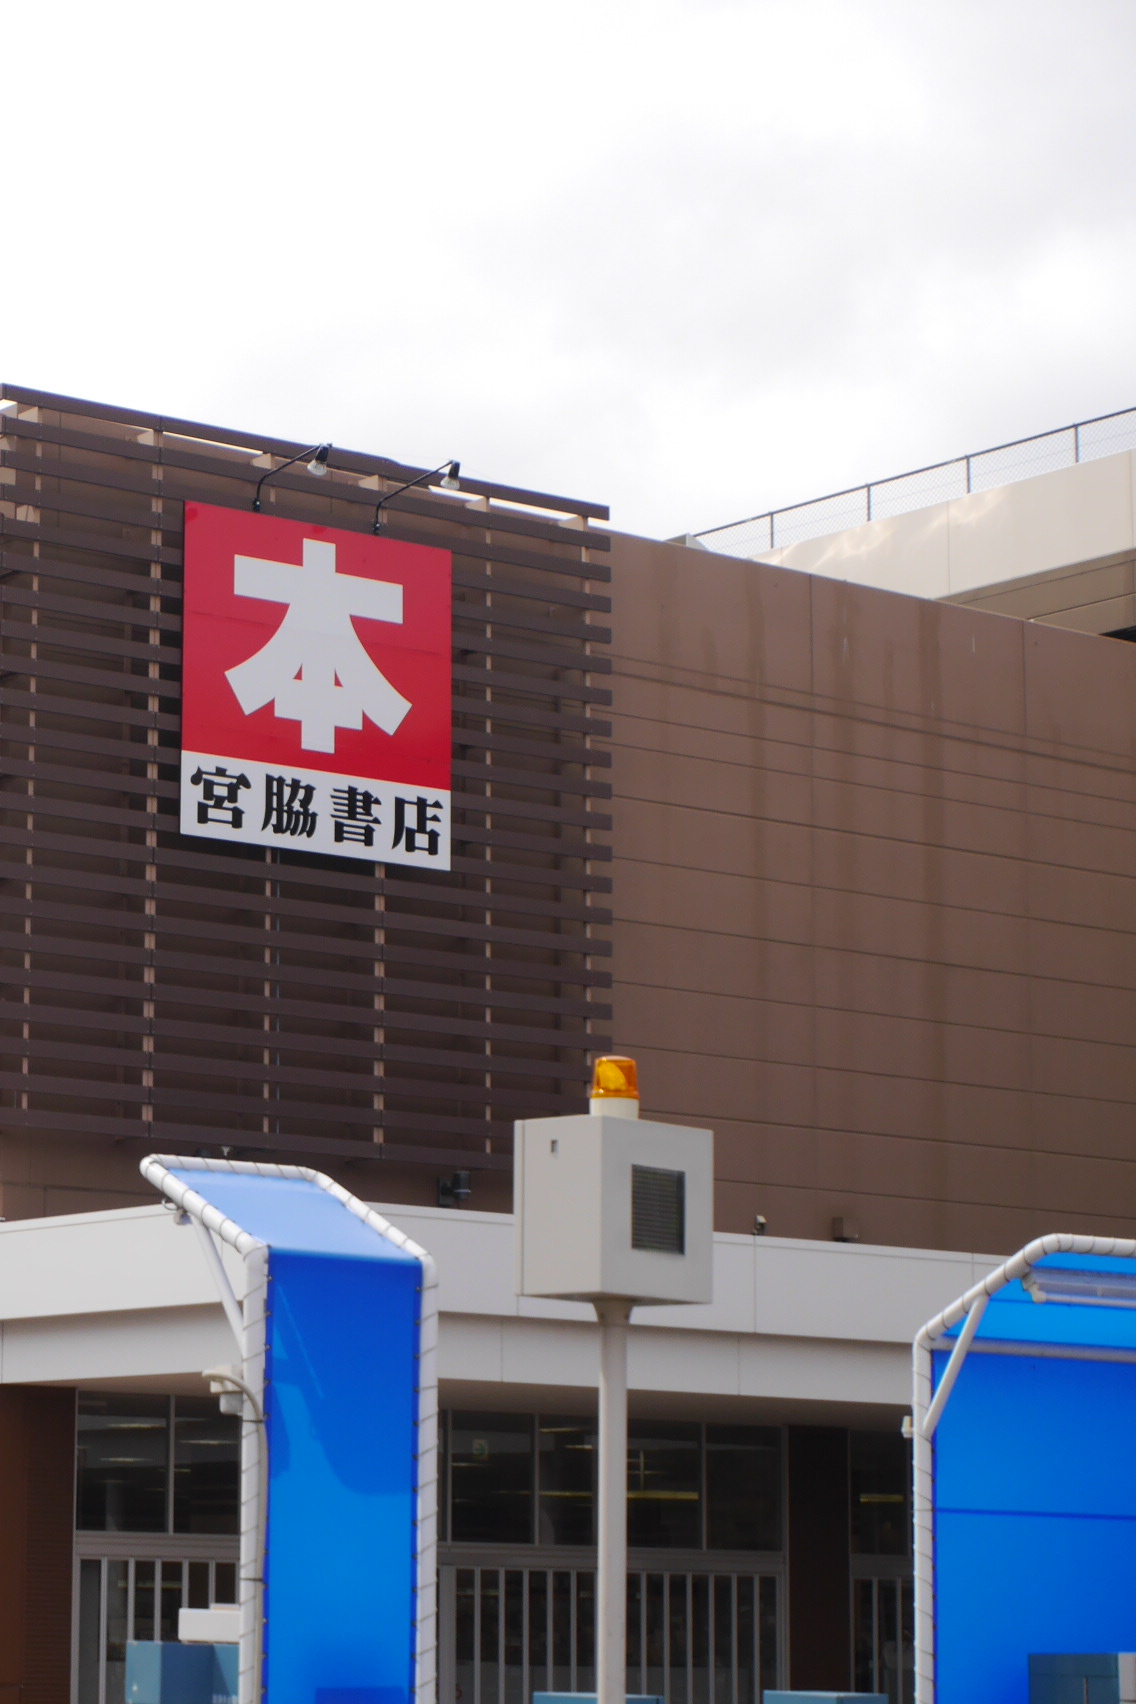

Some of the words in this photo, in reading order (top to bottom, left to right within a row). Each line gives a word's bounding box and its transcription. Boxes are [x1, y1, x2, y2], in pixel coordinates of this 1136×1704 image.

[224, 537, 412, 754] 本
[190, 765, 444, 856] 宮脇書店
